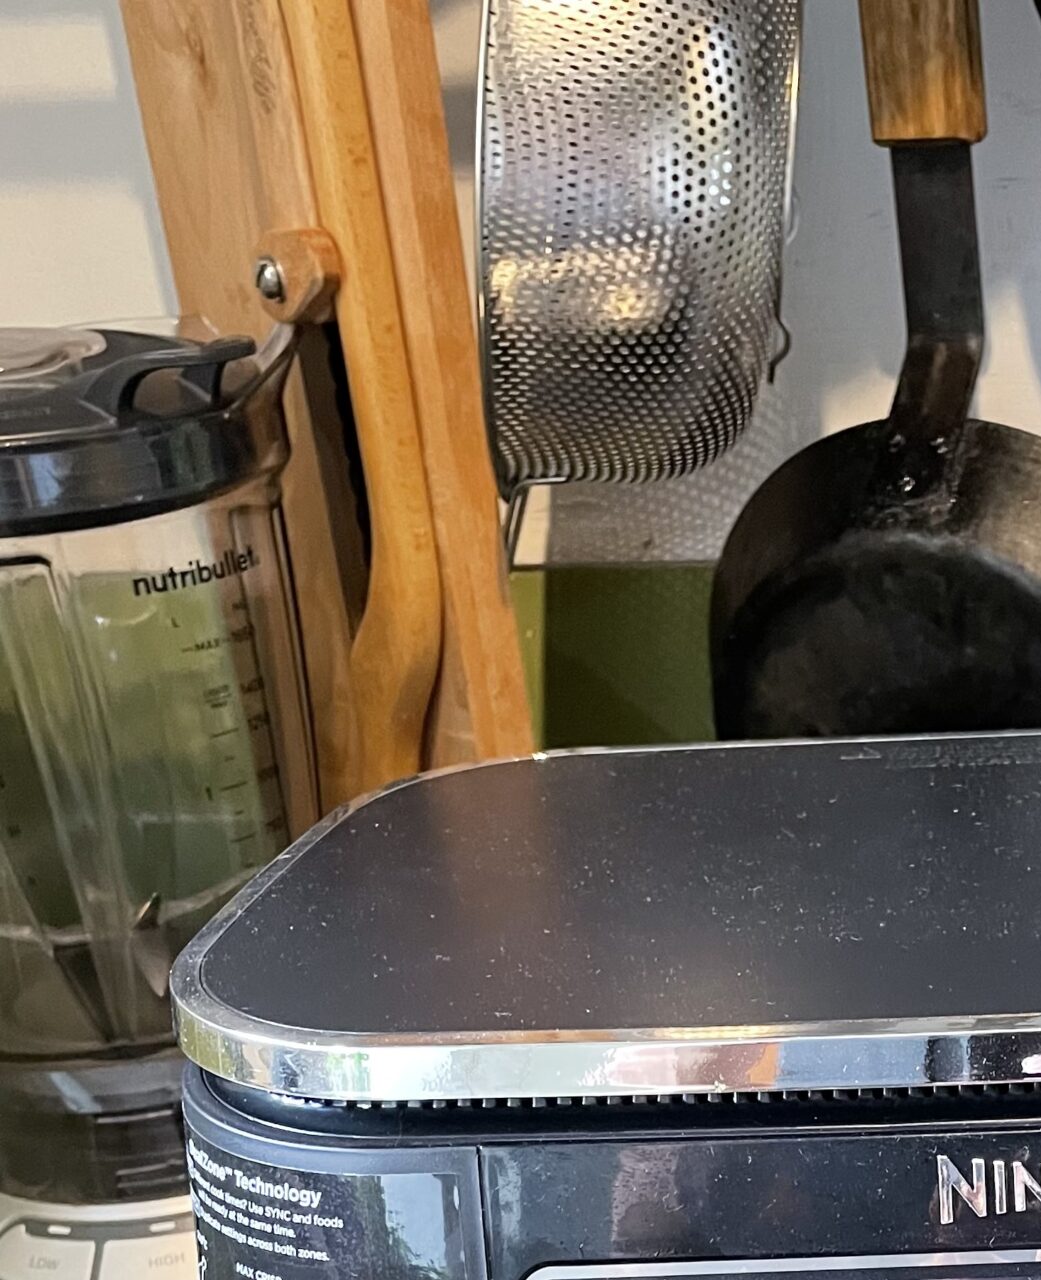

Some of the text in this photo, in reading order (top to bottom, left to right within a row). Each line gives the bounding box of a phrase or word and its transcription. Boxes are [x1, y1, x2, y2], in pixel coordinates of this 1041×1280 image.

[233, 1170, 322, 1208] Technology
[228, 1210, 237, 1221] at
[237, 1212, 250, 1227] the
[250, 1218, 273, 1233] same
[273, 1223, 297, 1238] time.
[248, 1201, 264, 1216] Use
[264, 1207, 291, 1221] SYNC
[292, 1212, 312, 1225] and
[313, 1214, 344, 1229] foods
[149, 1252, 185, 1269] HIGH
[247, 1236, 273, 1251] across
[274, 1241, 297, 1257] both
[297, 1247, 330, 1262] zones.
[236, 1262, 254, 1279] MAX
